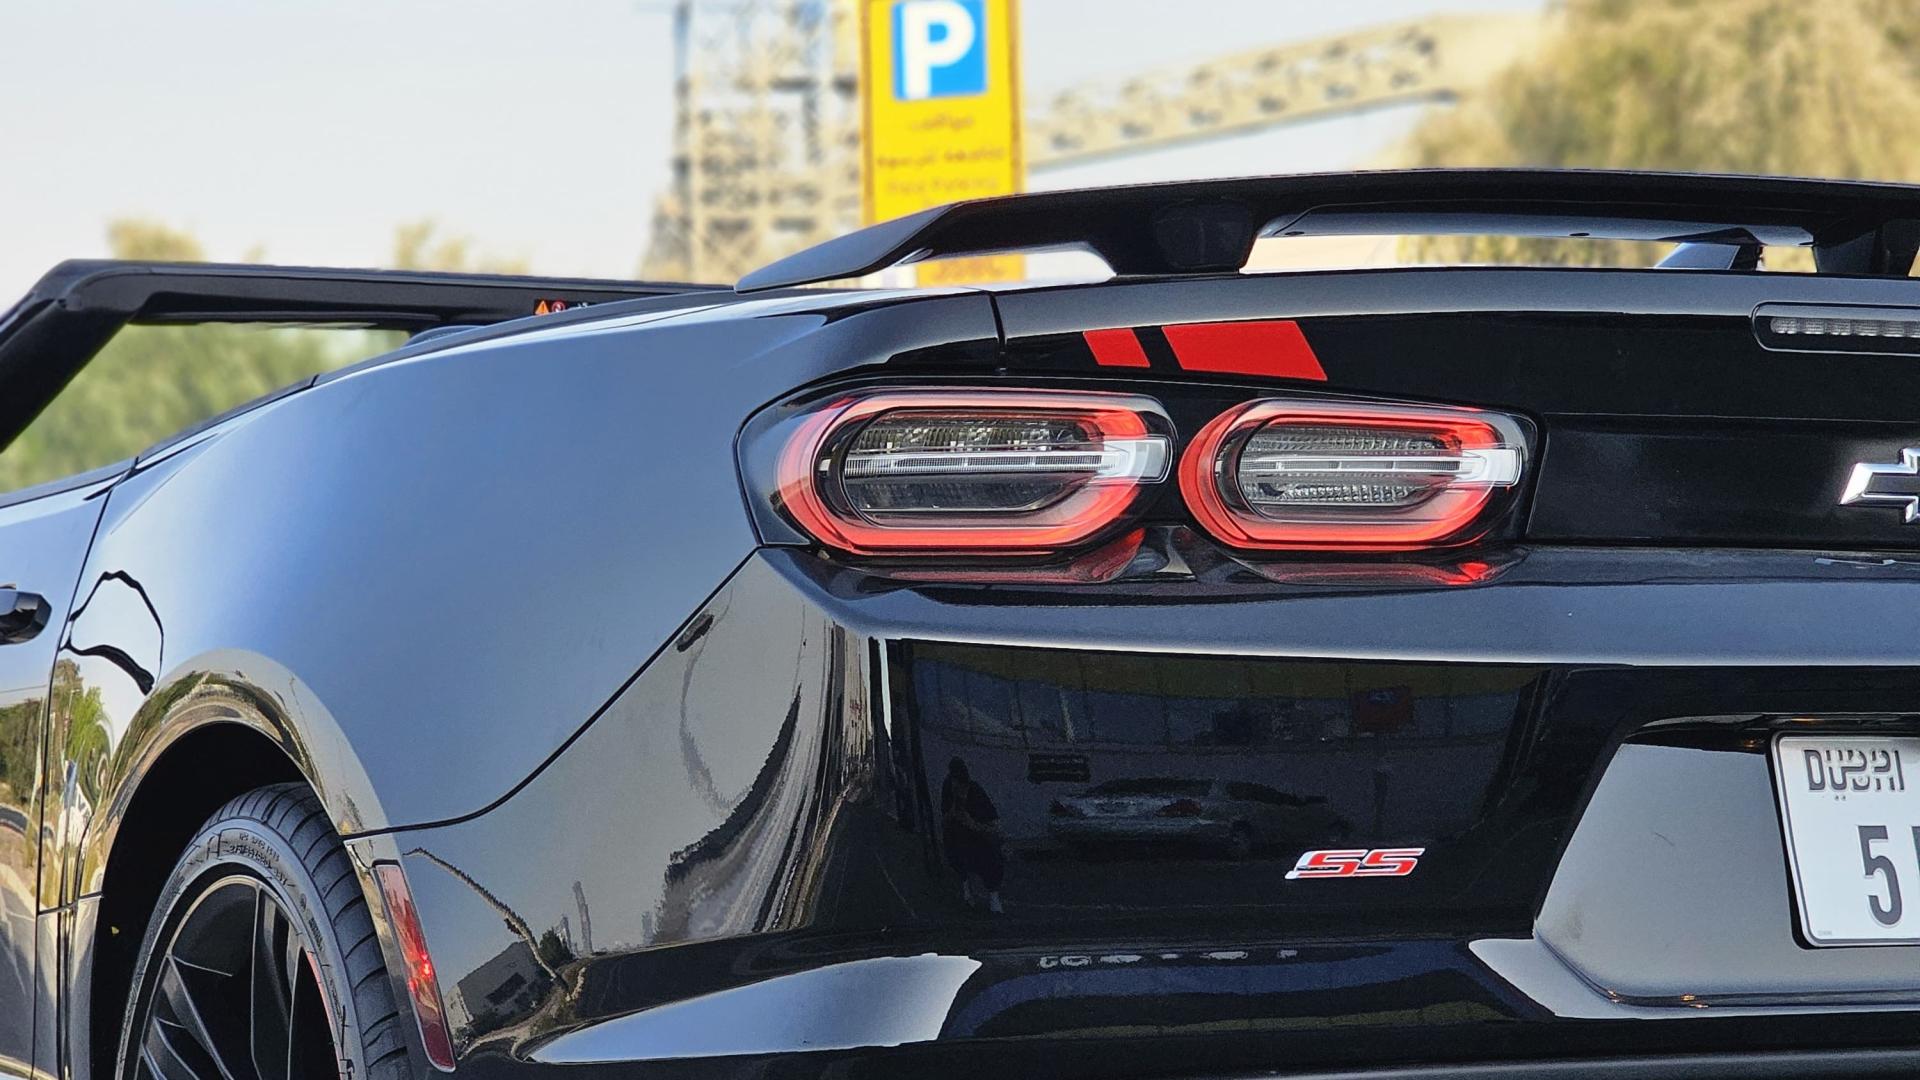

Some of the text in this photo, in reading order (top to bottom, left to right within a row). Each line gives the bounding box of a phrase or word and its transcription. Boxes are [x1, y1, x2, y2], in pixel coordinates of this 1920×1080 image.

[902, 1, 975, 98] P
[1285, 848, 1425, 879] SS
[1858, 825, 1920, 925] 5
